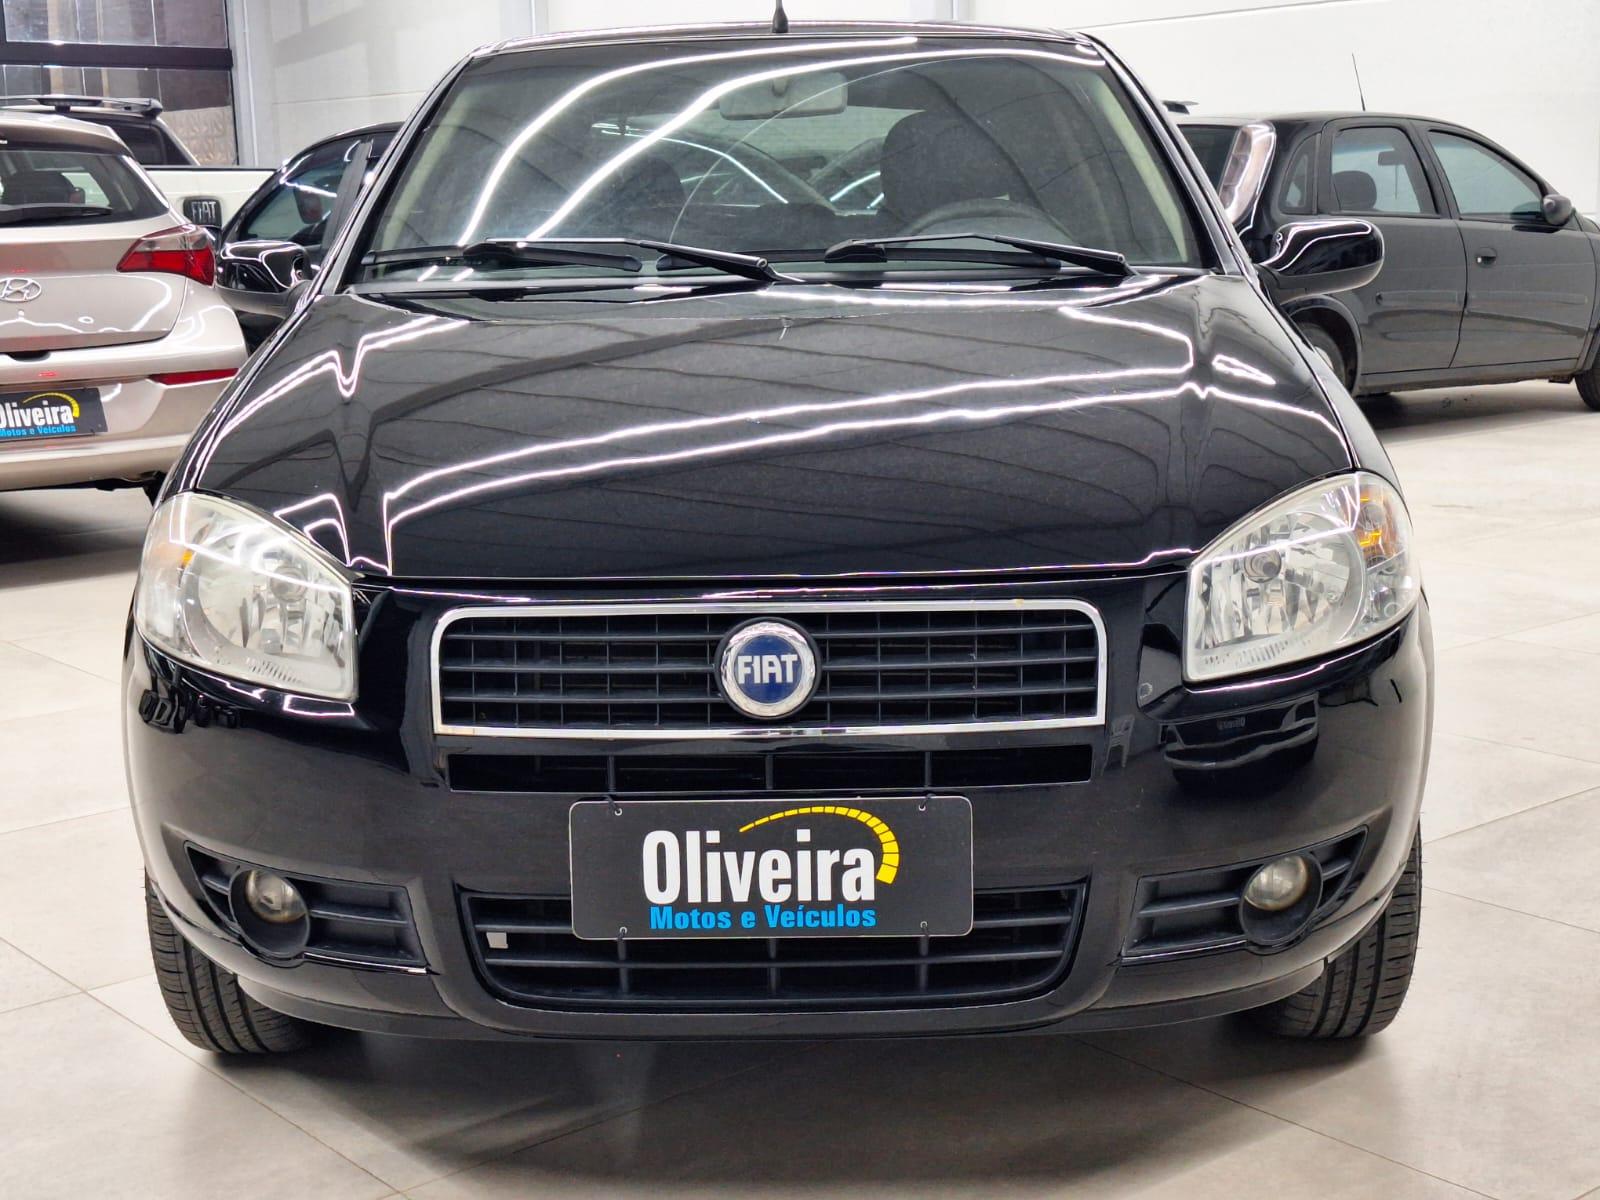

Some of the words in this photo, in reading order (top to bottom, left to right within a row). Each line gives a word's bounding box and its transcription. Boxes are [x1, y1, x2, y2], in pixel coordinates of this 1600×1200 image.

[191, 201, 217, 222] FIAT
[737, 653, 798, 685] FIAT
[642, 828, 875, 905] Oliveira
[650, 906, 732, 930] Motos
[740, 911, 756, 929] e
[764, 903, 877, 929] Veículos
